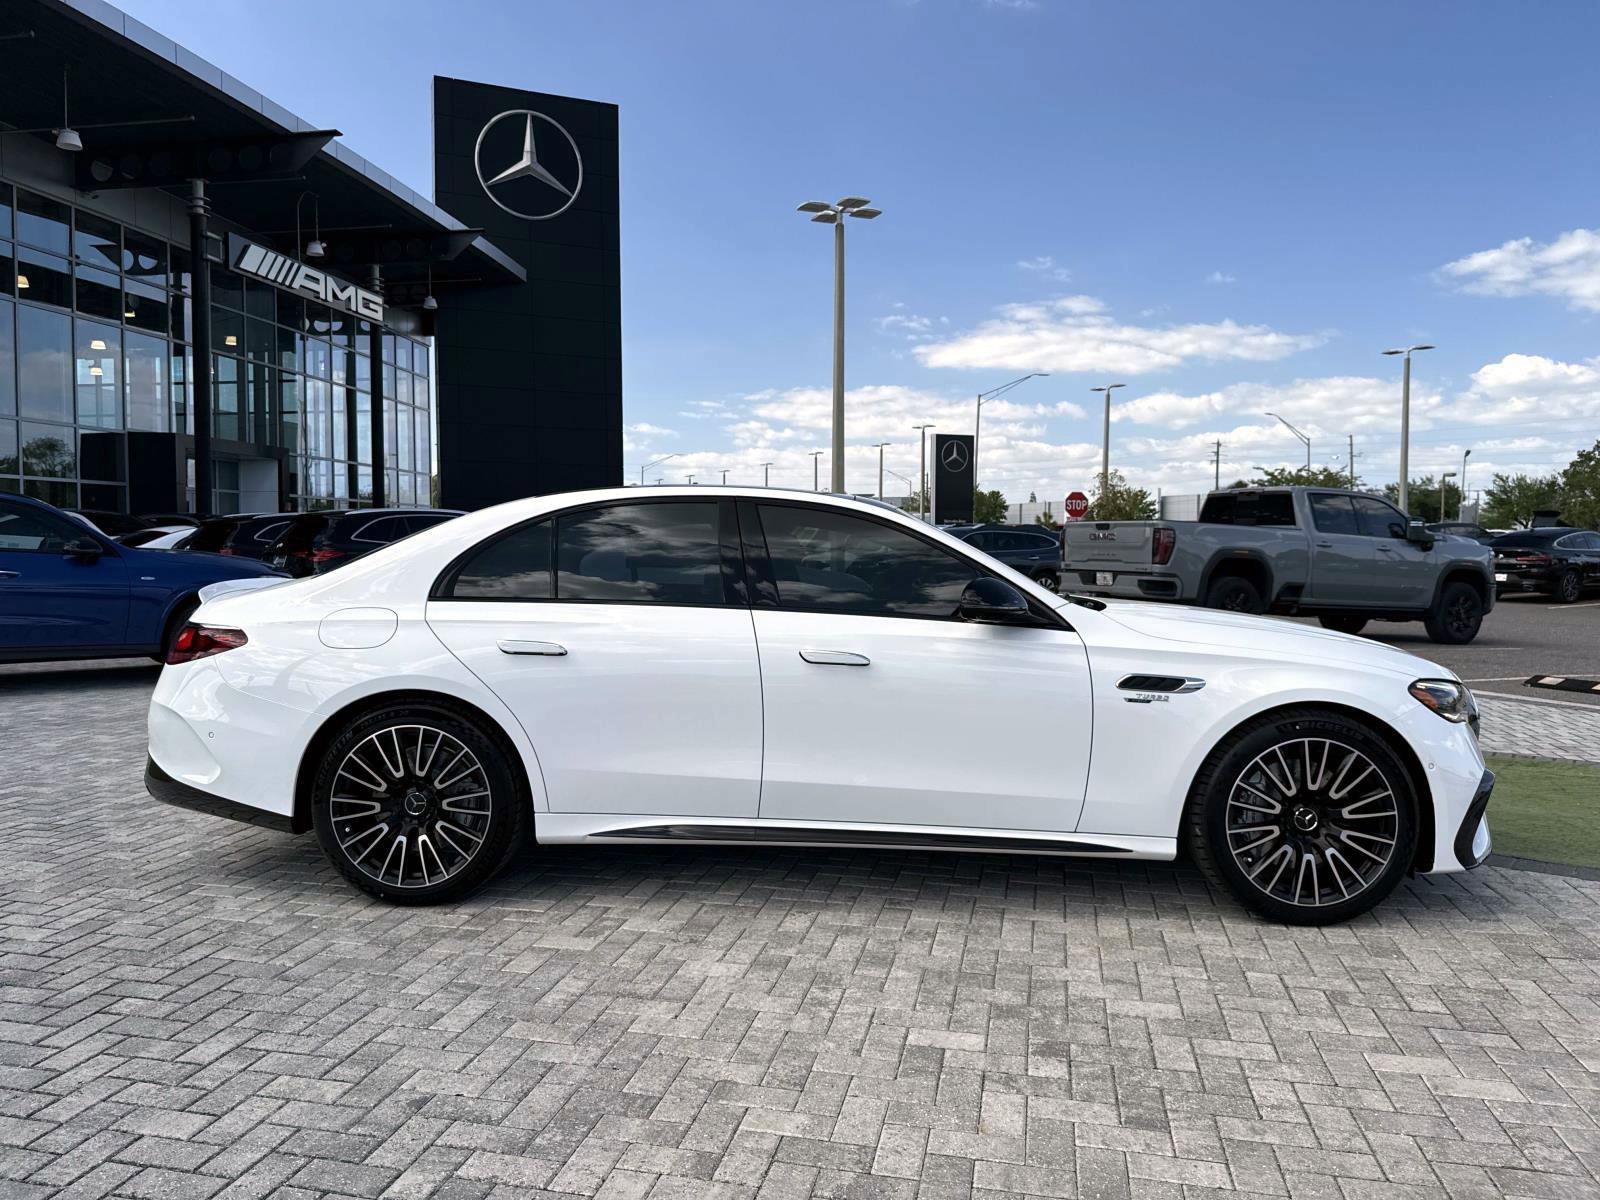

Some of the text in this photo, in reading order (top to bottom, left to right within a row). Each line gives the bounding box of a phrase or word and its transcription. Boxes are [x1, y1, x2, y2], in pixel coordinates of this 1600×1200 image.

[291, 264, 384, 322] AMG
[1066, 500, 1088, 510] STOP
[1089, 531, 1117, 541] GMC
[1135, 693, 1170, 701] TURBO
